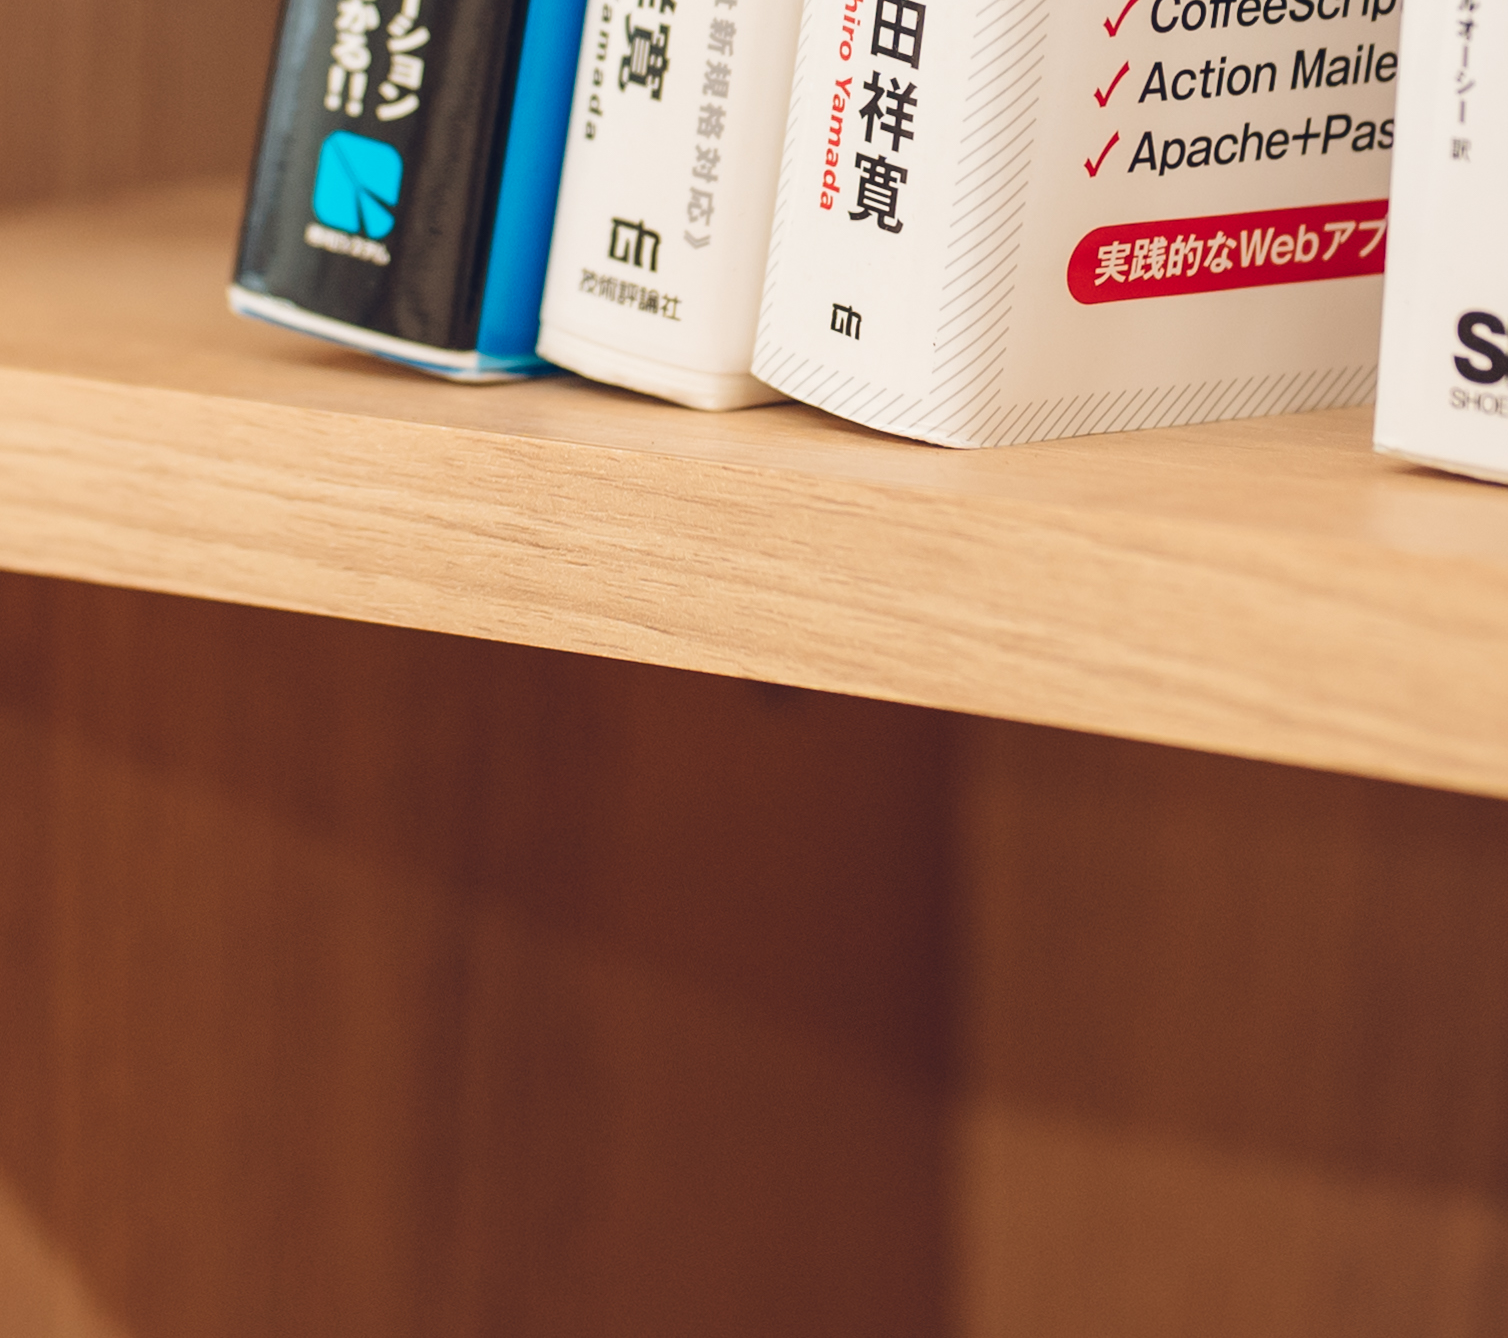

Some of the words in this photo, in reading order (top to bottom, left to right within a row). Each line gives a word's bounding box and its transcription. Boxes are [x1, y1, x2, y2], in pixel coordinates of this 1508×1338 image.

[1138, 56, 1277, 103] Action
[1290, 43, 1398, 90] Maile
[820, 76, 854, 211] Yamada
[1128, 113, 1395, 177] Apache+Pas
[578, 267, 683, 322] 技術評論社
